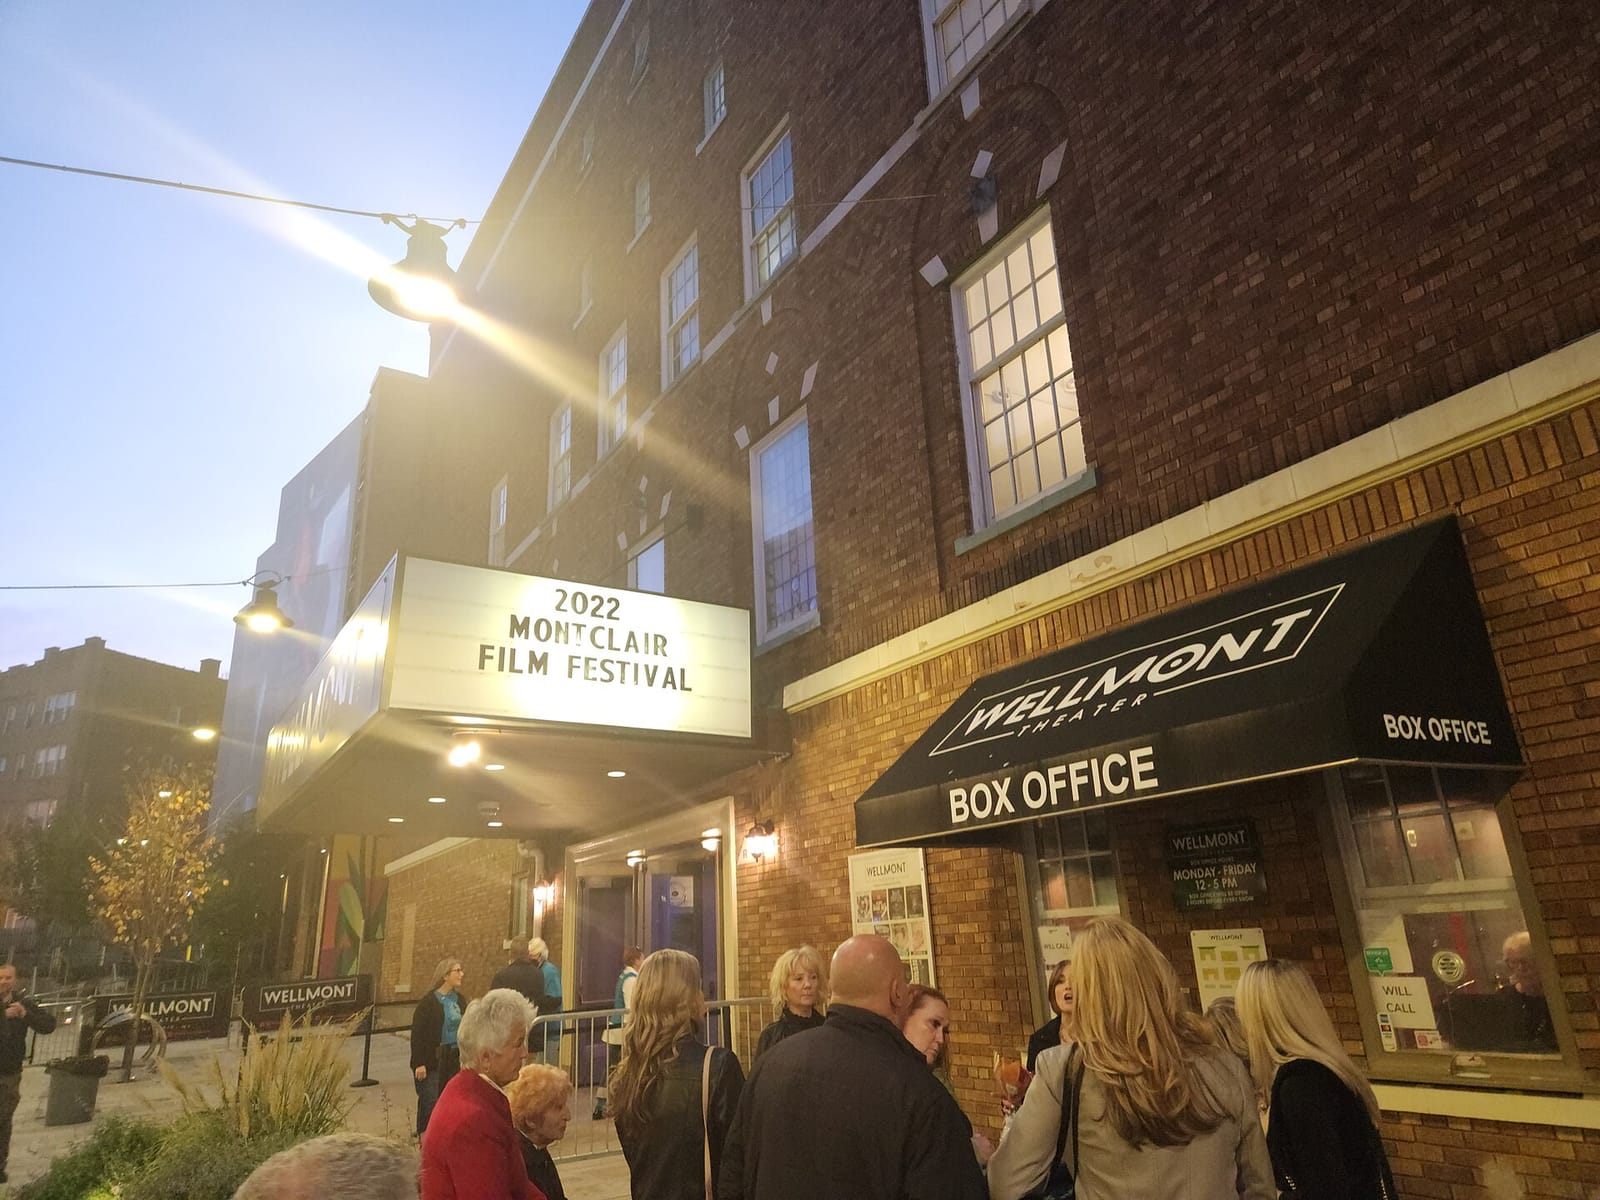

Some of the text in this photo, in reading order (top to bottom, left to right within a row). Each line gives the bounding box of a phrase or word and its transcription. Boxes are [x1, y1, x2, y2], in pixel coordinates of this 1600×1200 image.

[554, 588, 621, 621] 2022
[510, 614, 667, 657] MONTCLAIR
[479, 644, 692, 691] FILM FESTIVAL
[964, 609, 1313, 737] WELLMONT
[1015, 692, 1146, 738] THEATER
[1382, 713, 1492, 745] BOX OFFICE
[950, 748, 1158, 823] BOX OFFICE
[1173, 831, 1245, 850] WELLMONT
[866, 863, 905, 876] WELLMONT
[1174, 867, 1215, 880] MONDAY
[1223, 863, 1256, 876] FRIDAY
[1196, 880, 1206, 891] 12
[1213, 878, 1220, 889] 5
[1221, 876, 1238, 889] PM
[264, 984, 353, 1004] WELLMONT
[1381, 985, 1413, 997] WILL
[113, 998, 211, 1015] WLLMONT
[1386, 1002, 1416, 1014] CALL
